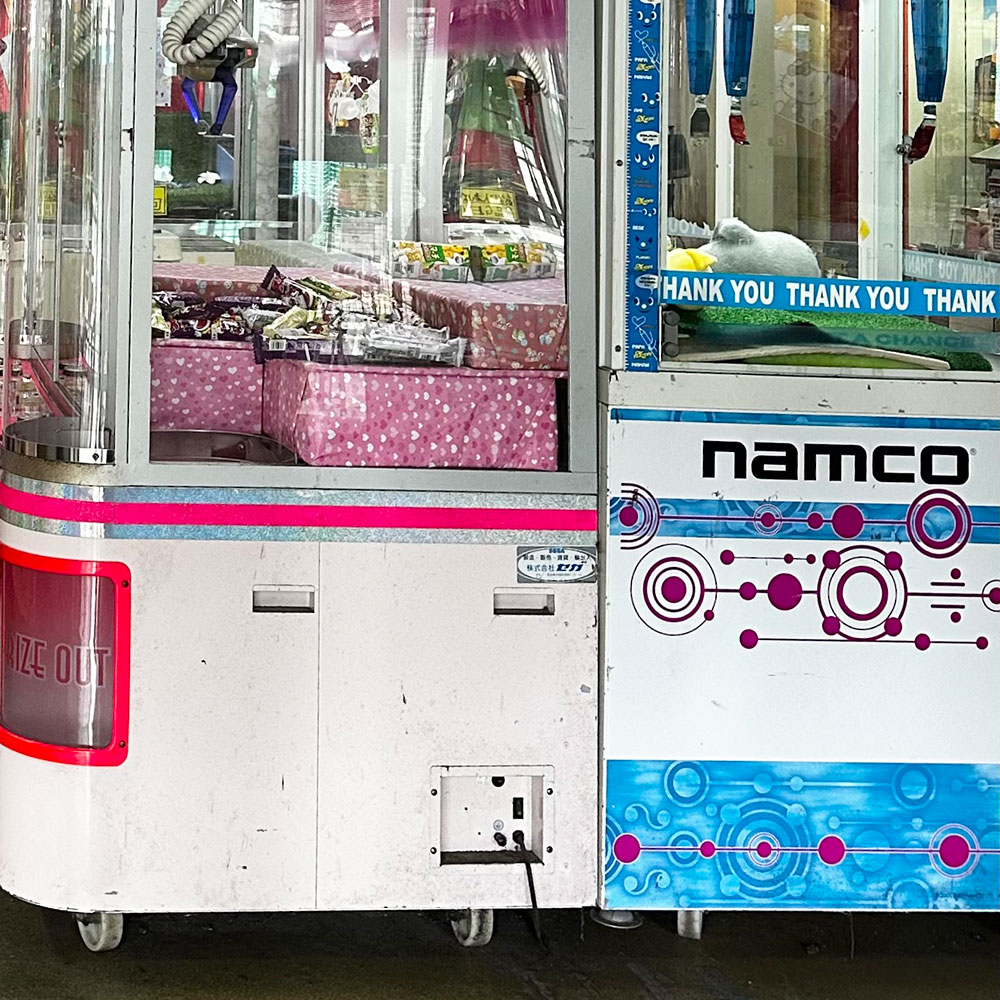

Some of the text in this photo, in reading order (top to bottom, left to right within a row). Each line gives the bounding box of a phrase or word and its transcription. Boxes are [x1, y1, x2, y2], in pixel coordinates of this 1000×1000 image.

[730, 280, 774, 305] YOU
[786, 282, 860, 309] THANK
[867, 286, 910, 311] YOU
[924, 288, 996, 314] THANK
[702, 439, 970, 486] namco
[55, 643, 111, 687] OUT
